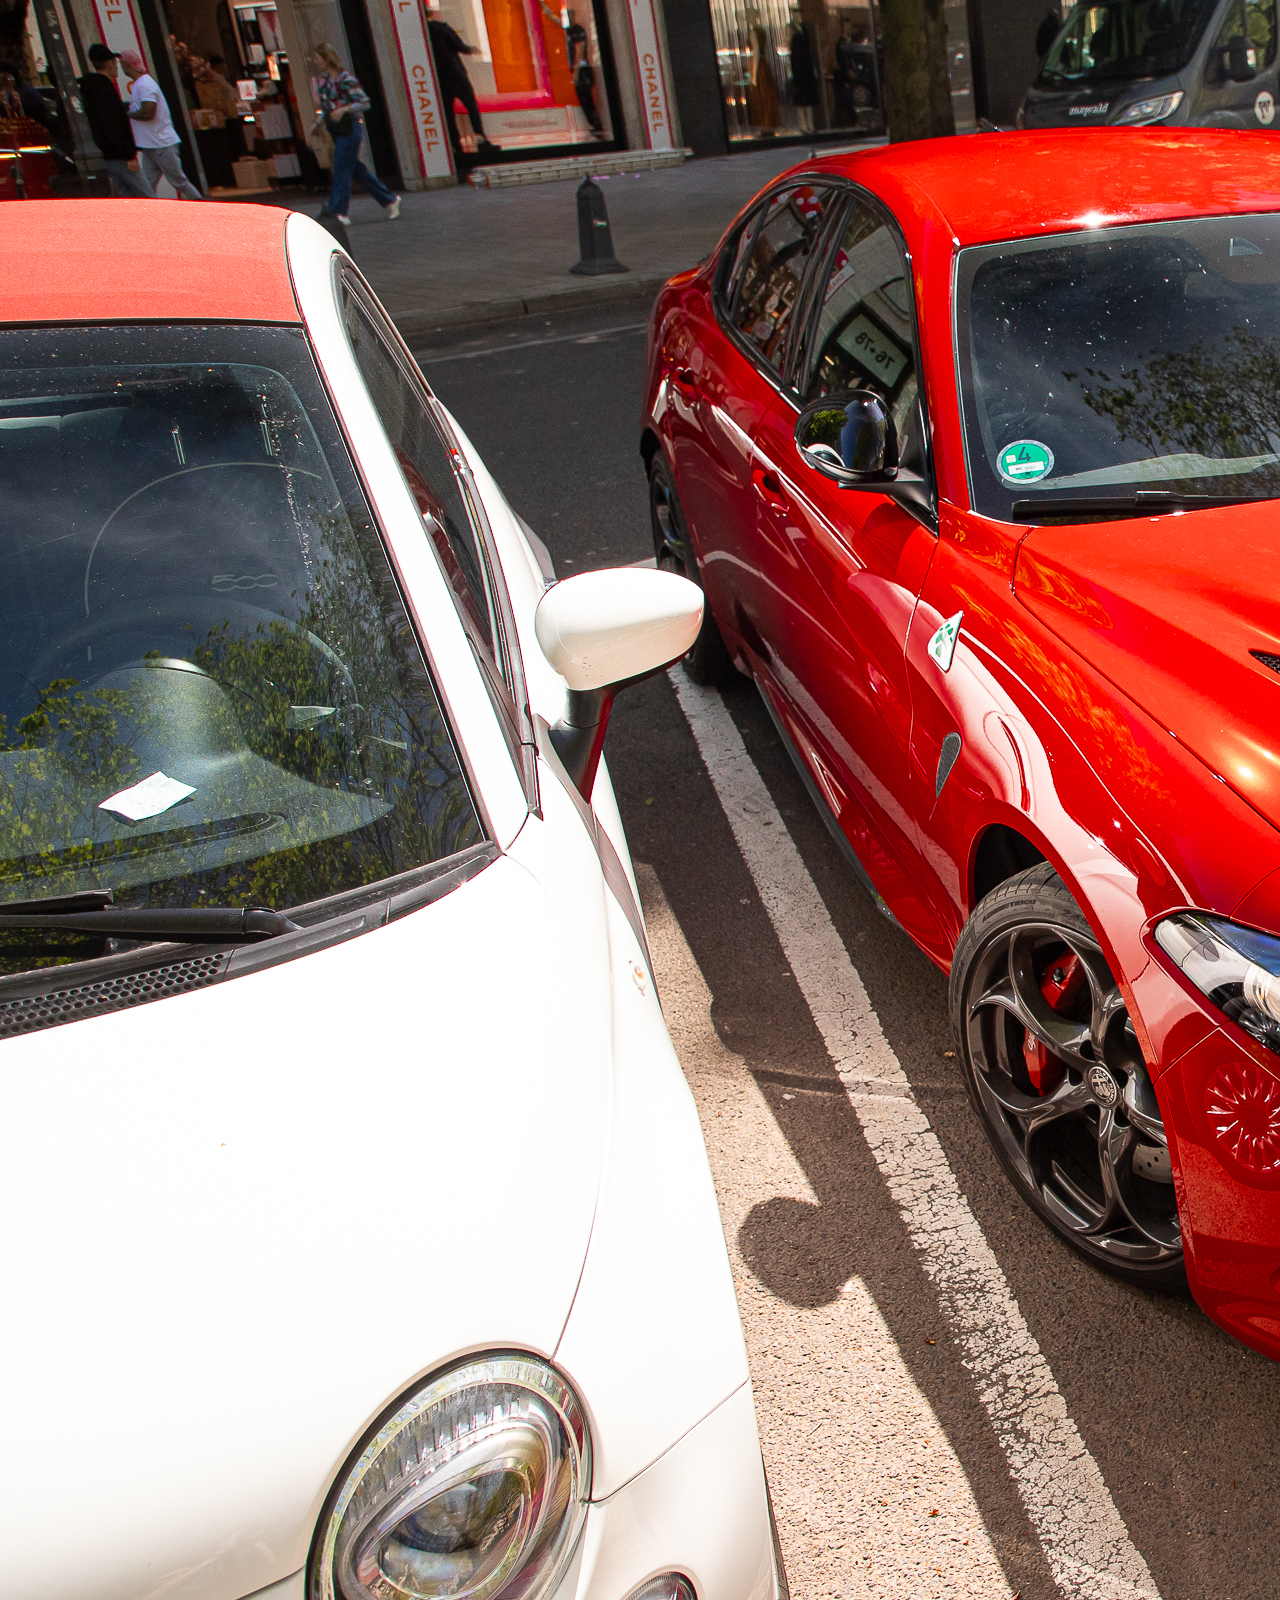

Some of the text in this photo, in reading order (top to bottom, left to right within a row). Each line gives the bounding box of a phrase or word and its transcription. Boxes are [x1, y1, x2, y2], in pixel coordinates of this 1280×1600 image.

[412, 65, 439, 152] CHANEL
[643, 53, 663, 133] CHANEL
[1018, 446, 1031, 461] 4
